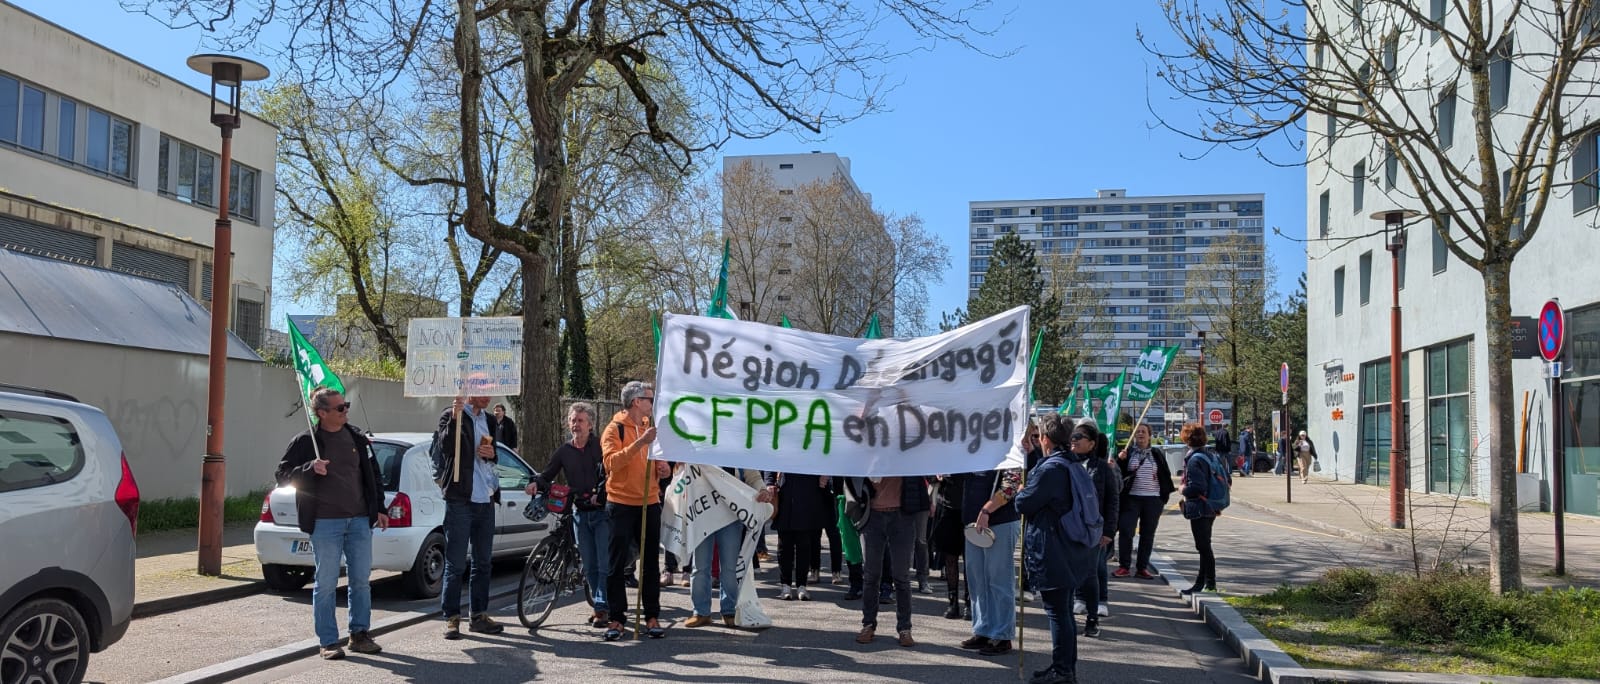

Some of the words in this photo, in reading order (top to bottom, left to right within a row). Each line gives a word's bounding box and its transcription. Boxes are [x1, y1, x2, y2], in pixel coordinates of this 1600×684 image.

[418, 328, 456, 346] NON
[683, 328, 819, 391] Région
[412, 364, 447, 388] OUI
[668, 396, 832, 454] CFPPA
[843, 413, 889, 447] en
[685, 494, 711, 526] VICE
